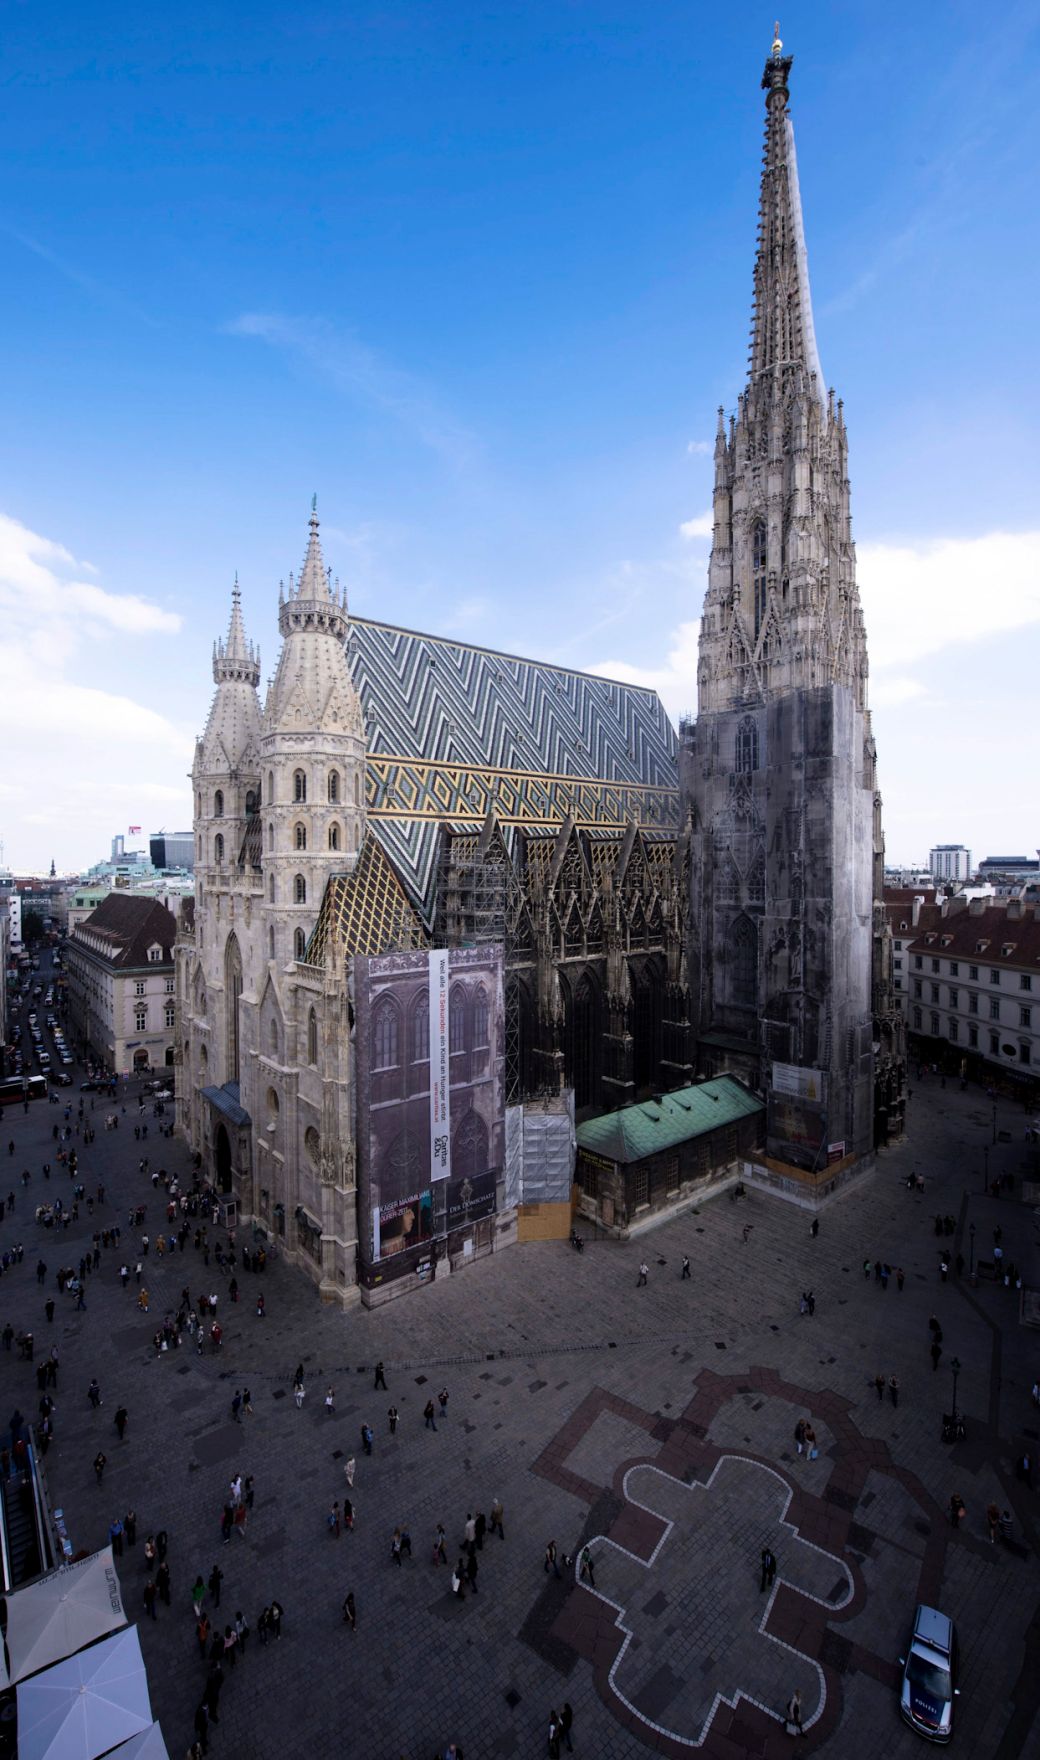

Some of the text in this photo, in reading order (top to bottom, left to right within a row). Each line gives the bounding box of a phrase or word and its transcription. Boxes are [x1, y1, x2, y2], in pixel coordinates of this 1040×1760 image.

[440, 990, 446, 998] 12
[440, 1065, 446, 1075] an
[440, 1135, 448, 1168] Caritas
[380, 1200, 398, 1213] KAISER
[915, 1698, 937, 1714] POLIZEI
